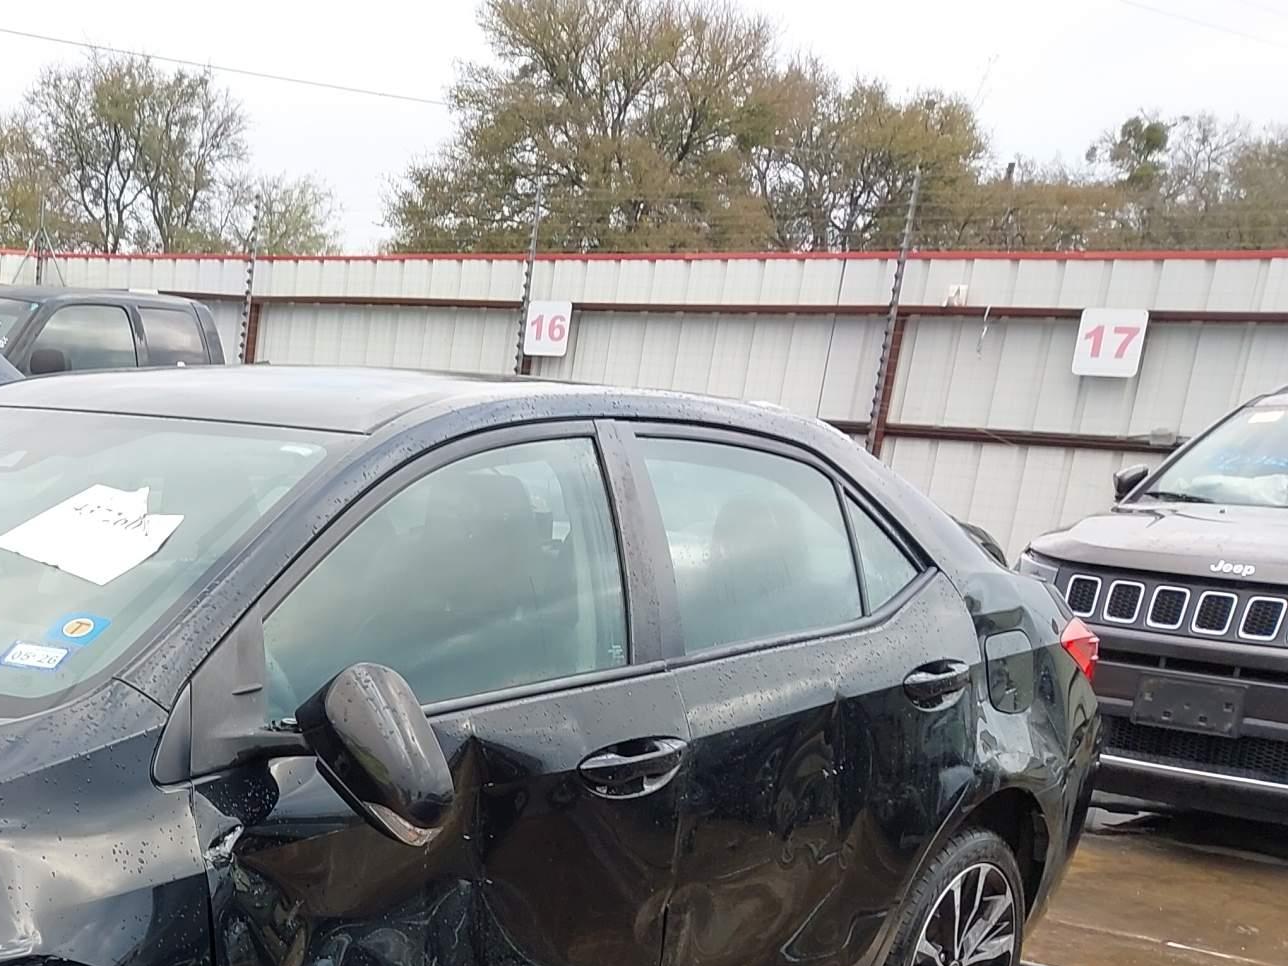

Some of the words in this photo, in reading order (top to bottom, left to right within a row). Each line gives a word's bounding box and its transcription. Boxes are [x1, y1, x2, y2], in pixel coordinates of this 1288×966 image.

[531, 314, 567, 342] 16
[1084, 325, 1141, 359] 17
[1211, 560, 1256, 577] Jeep
